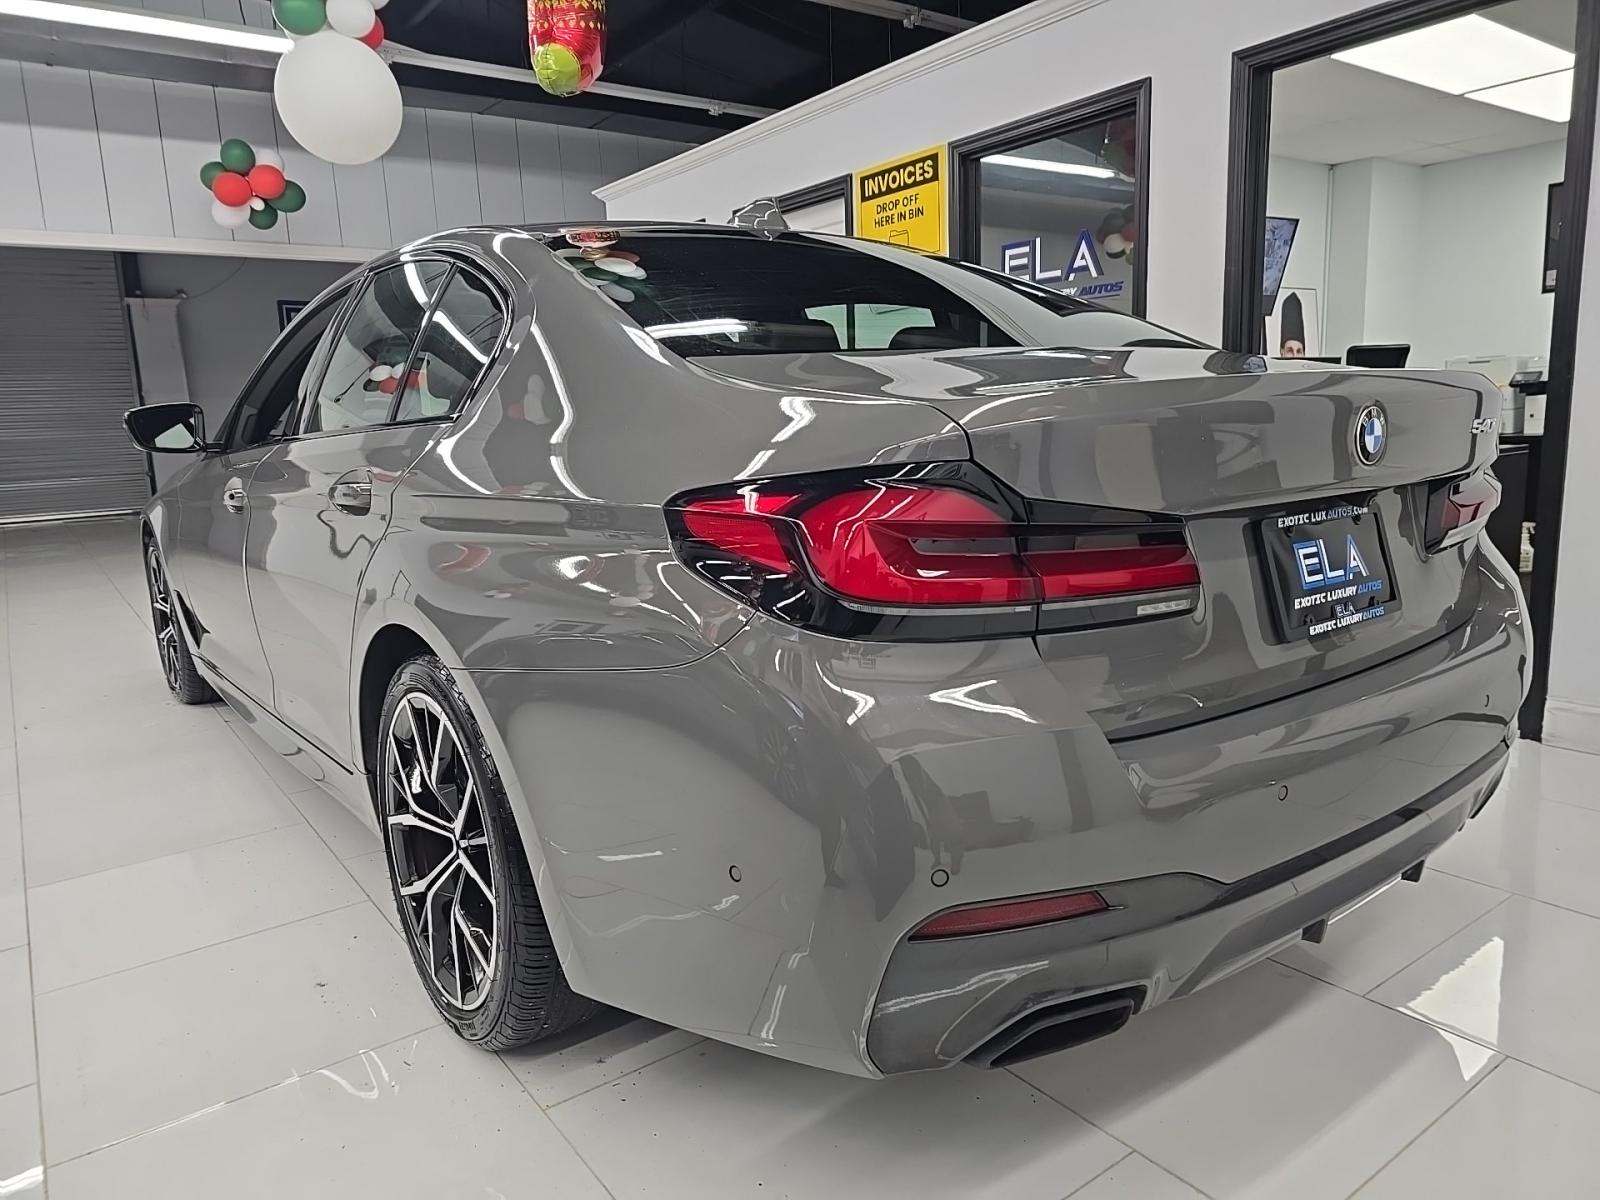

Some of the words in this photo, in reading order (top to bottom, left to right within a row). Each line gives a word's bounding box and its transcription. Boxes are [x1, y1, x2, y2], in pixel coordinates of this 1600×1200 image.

[864, 159, 934, 197] INVOICES
[874, 213, 895, 228] HERE
[897, 210, 907, 223] IN
[908, 206, 924, 220] BIN
[876, 198, 900, 215] DROP
[902, 193, 920, 207] OFF
[1001, 228, 1104, 283] ELA
[1078, 280, 1124, 297] AUTOS
[1278, 513, 1310, 528] EXOTIC
[1311, 510, 1327, 523] LUX
[1292, 534, 1370, 590] ELA
[1294, 593, 1326, 610] EXOTIC
[1327, 585, 1357, 602] LUXURY
[1357, 580, 1382, 594] AUTOS
[1309, 621, 1337, 636] EXOTIC
[1337, 611, 1364, 628] LUXURY
[1362, 606, 1385, 619] AUTOS
[1335, 601, 1356, 618] ELA
